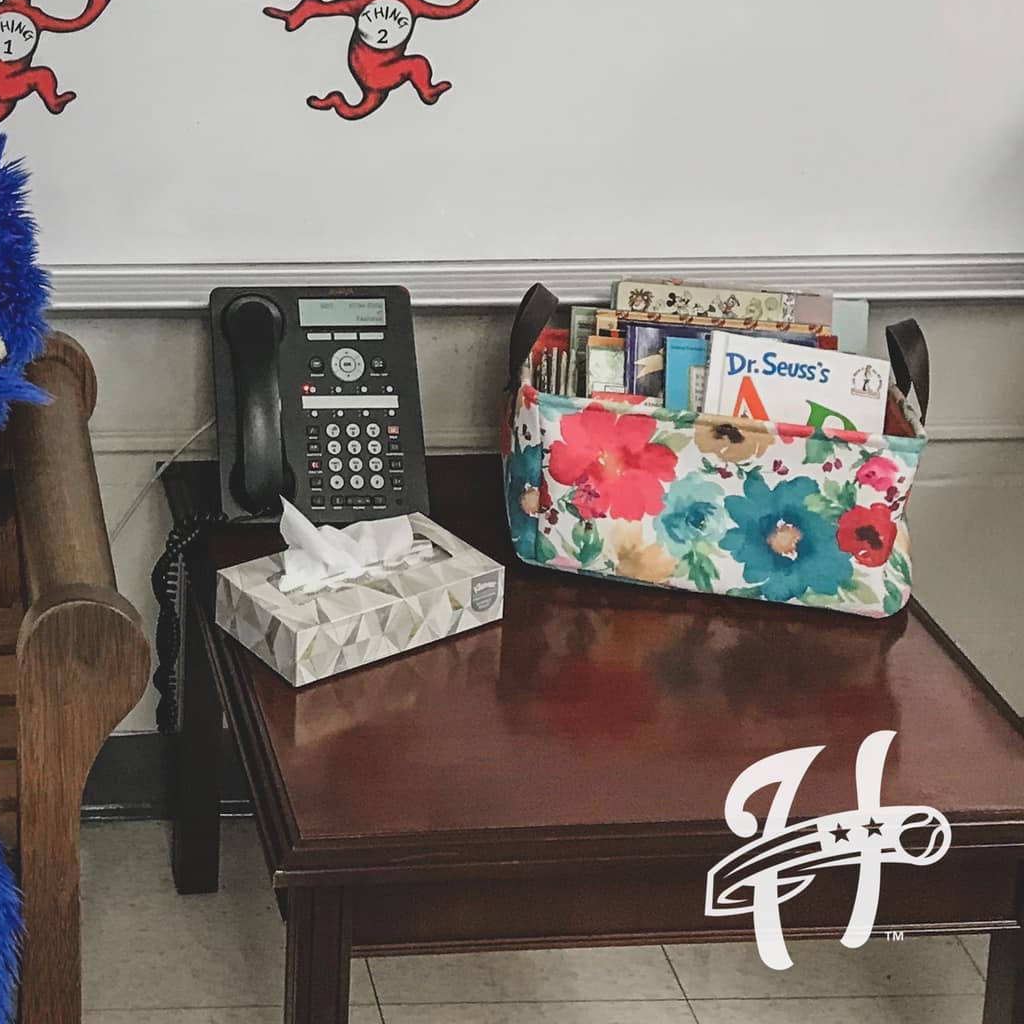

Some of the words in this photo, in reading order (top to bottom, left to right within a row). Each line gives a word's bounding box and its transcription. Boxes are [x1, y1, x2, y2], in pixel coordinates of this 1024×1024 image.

[361, 5, 409, 29] THING
[376, 28, 388, 45] 2
[3, 39, 13, 55] 1
[725, 352, 760, 376] Dr.
[762, 351, 832, 384] Seuss's
